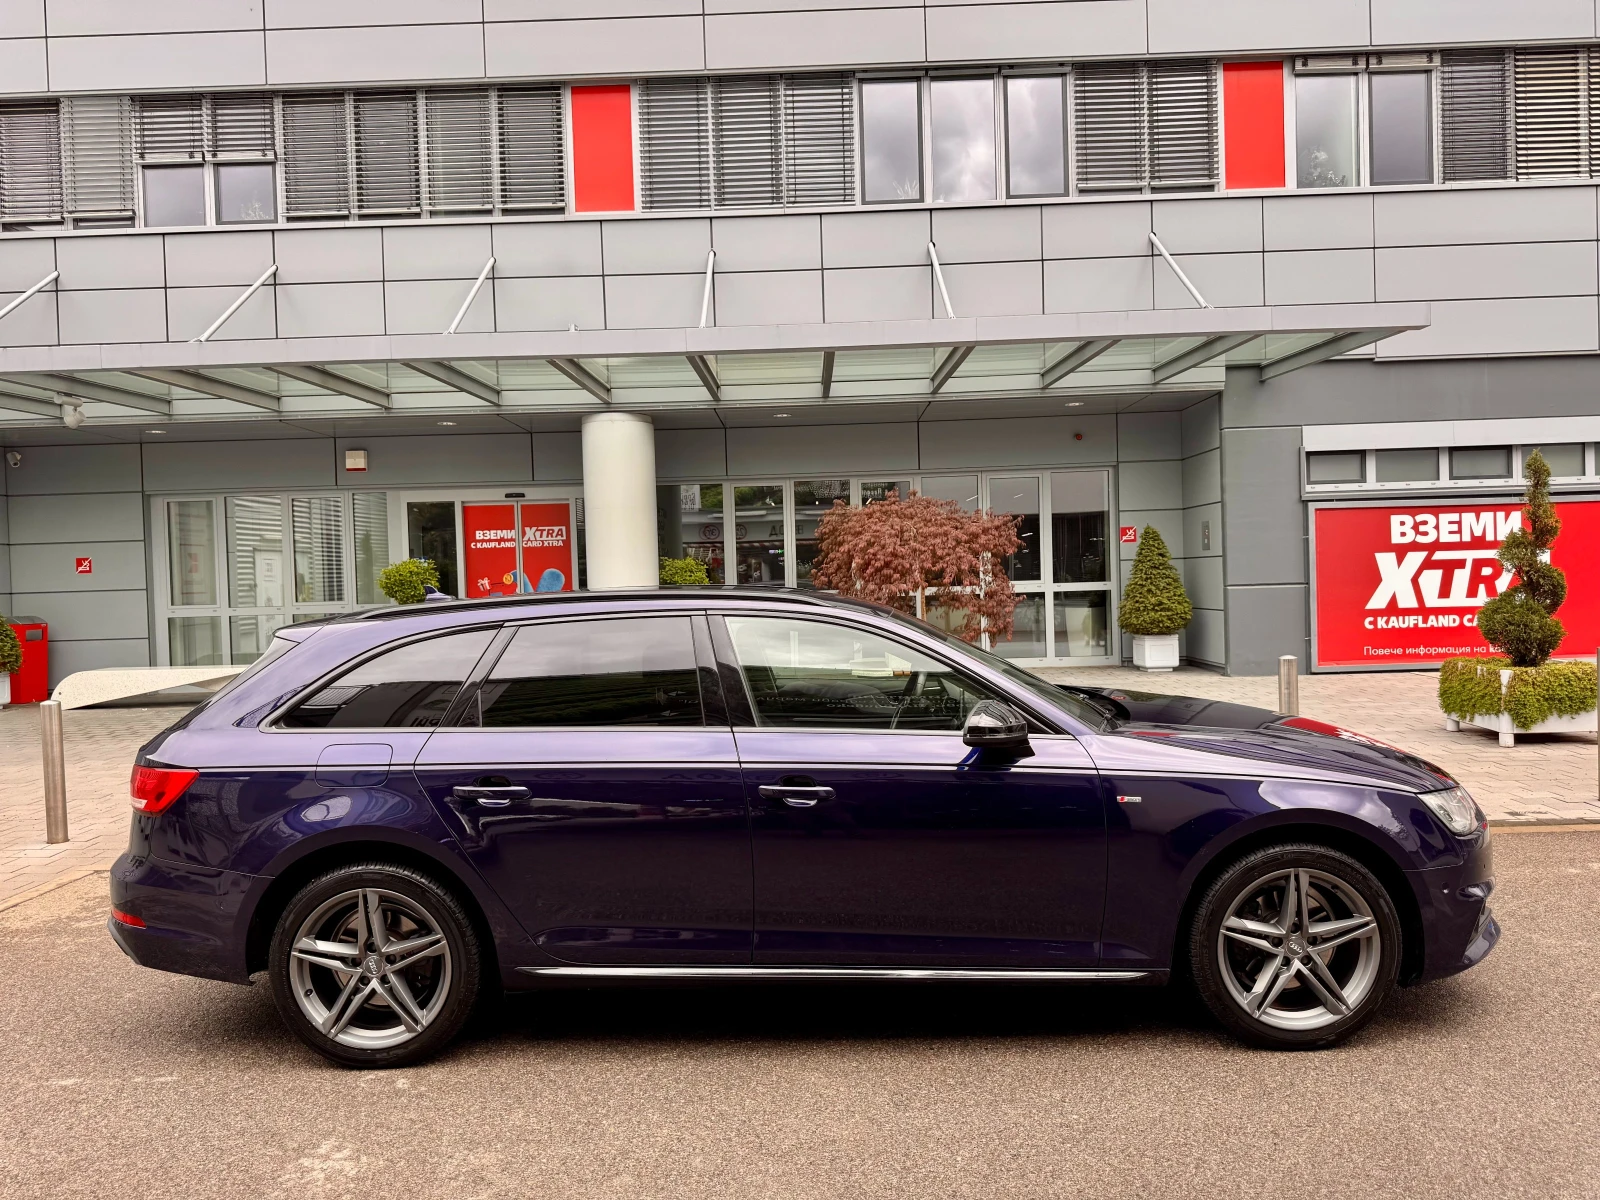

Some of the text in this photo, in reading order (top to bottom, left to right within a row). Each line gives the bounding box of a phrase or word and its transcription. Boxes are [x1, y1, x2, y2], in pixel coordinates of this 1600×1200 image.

[476, 526, 566, 540] ВЗЕМИ XTRA
[1390, 511, 1522, 544] ВЗЕМИ
[1377, 614, 1460, 629] KAUFLAND
[1363, 645, 1403, 656] Повече
[1405, 644, 1471, 656] информация
[1473, 645, 1487, 653] на
